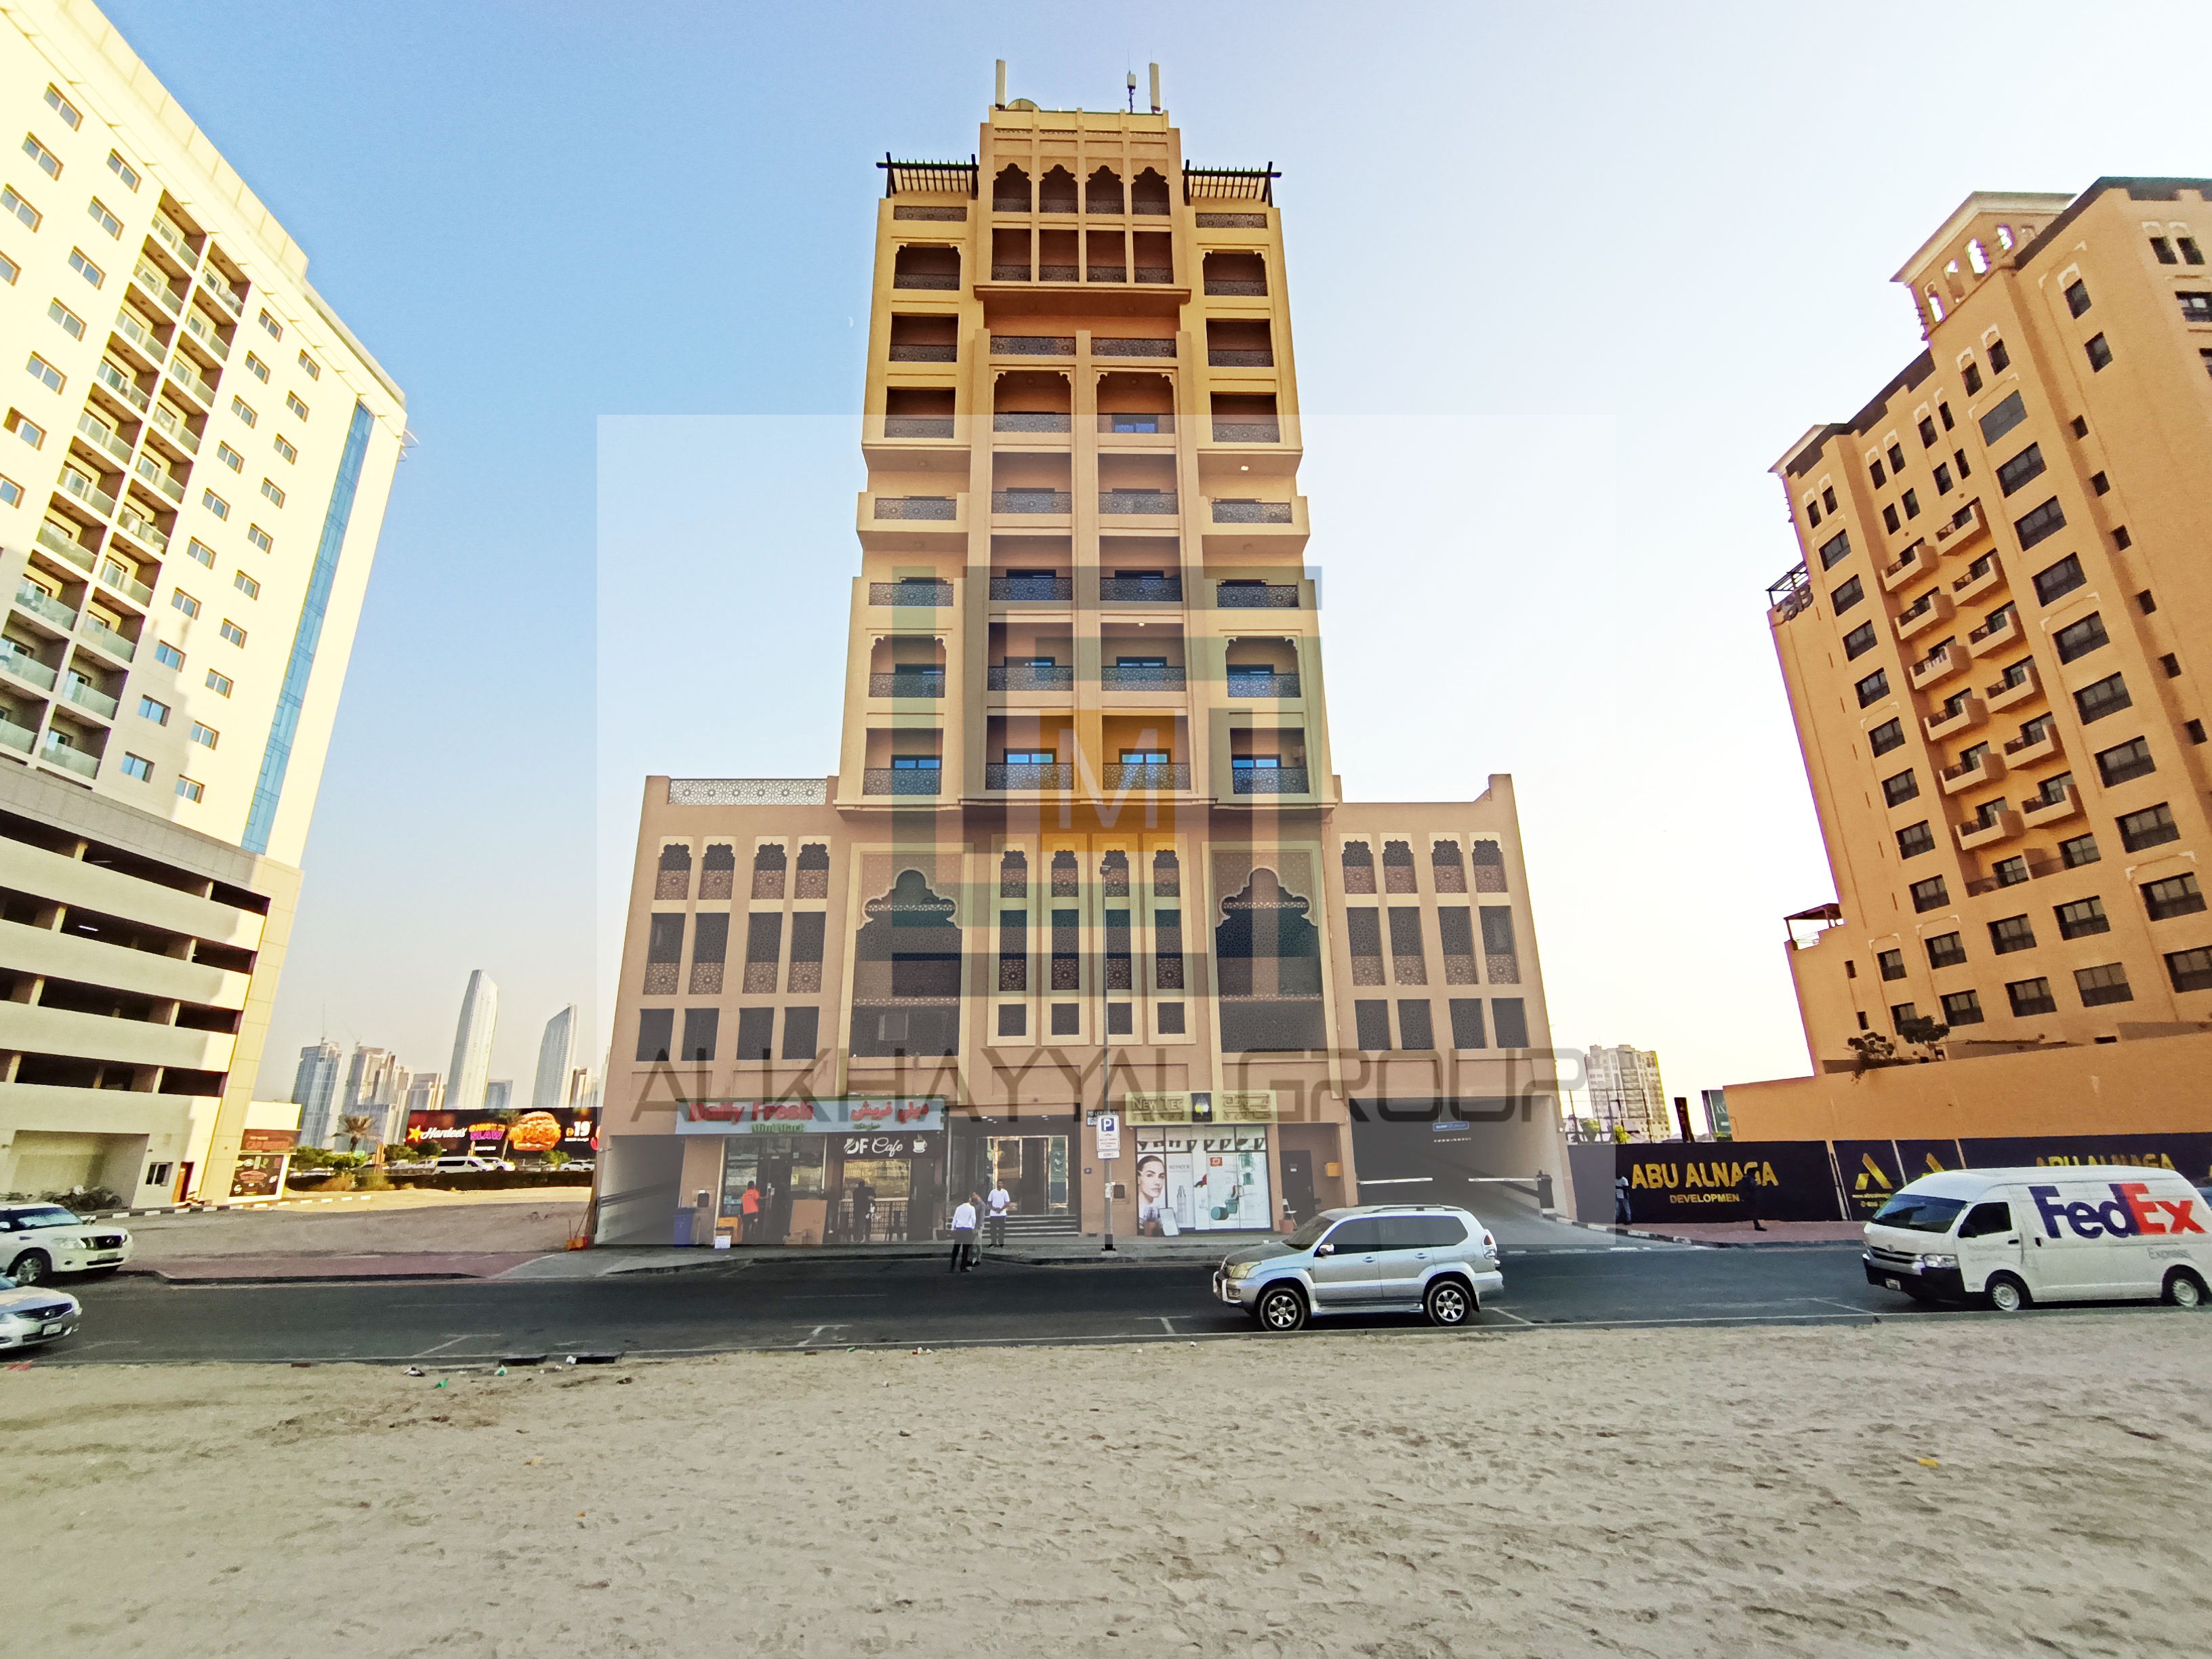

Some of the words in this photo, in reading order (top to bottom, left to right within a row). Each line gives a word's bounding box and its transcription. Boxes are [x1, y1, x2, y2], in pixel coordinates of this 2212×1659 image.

[687, 1102, 745, 1125] Daily
[751, 1100, 814, 1121] Fresh
[574, 1121, 591, 1136] 19
[1103, 1118, 1113, 1131] P
[872, 1137, 903, 1158] Cafe
[1631, 1163, 1679, 1189] ABU
[1669, 1193, 1744, 1204] DEVELOPMEN
[2028, 1183, 2207, 1239] FedEx
